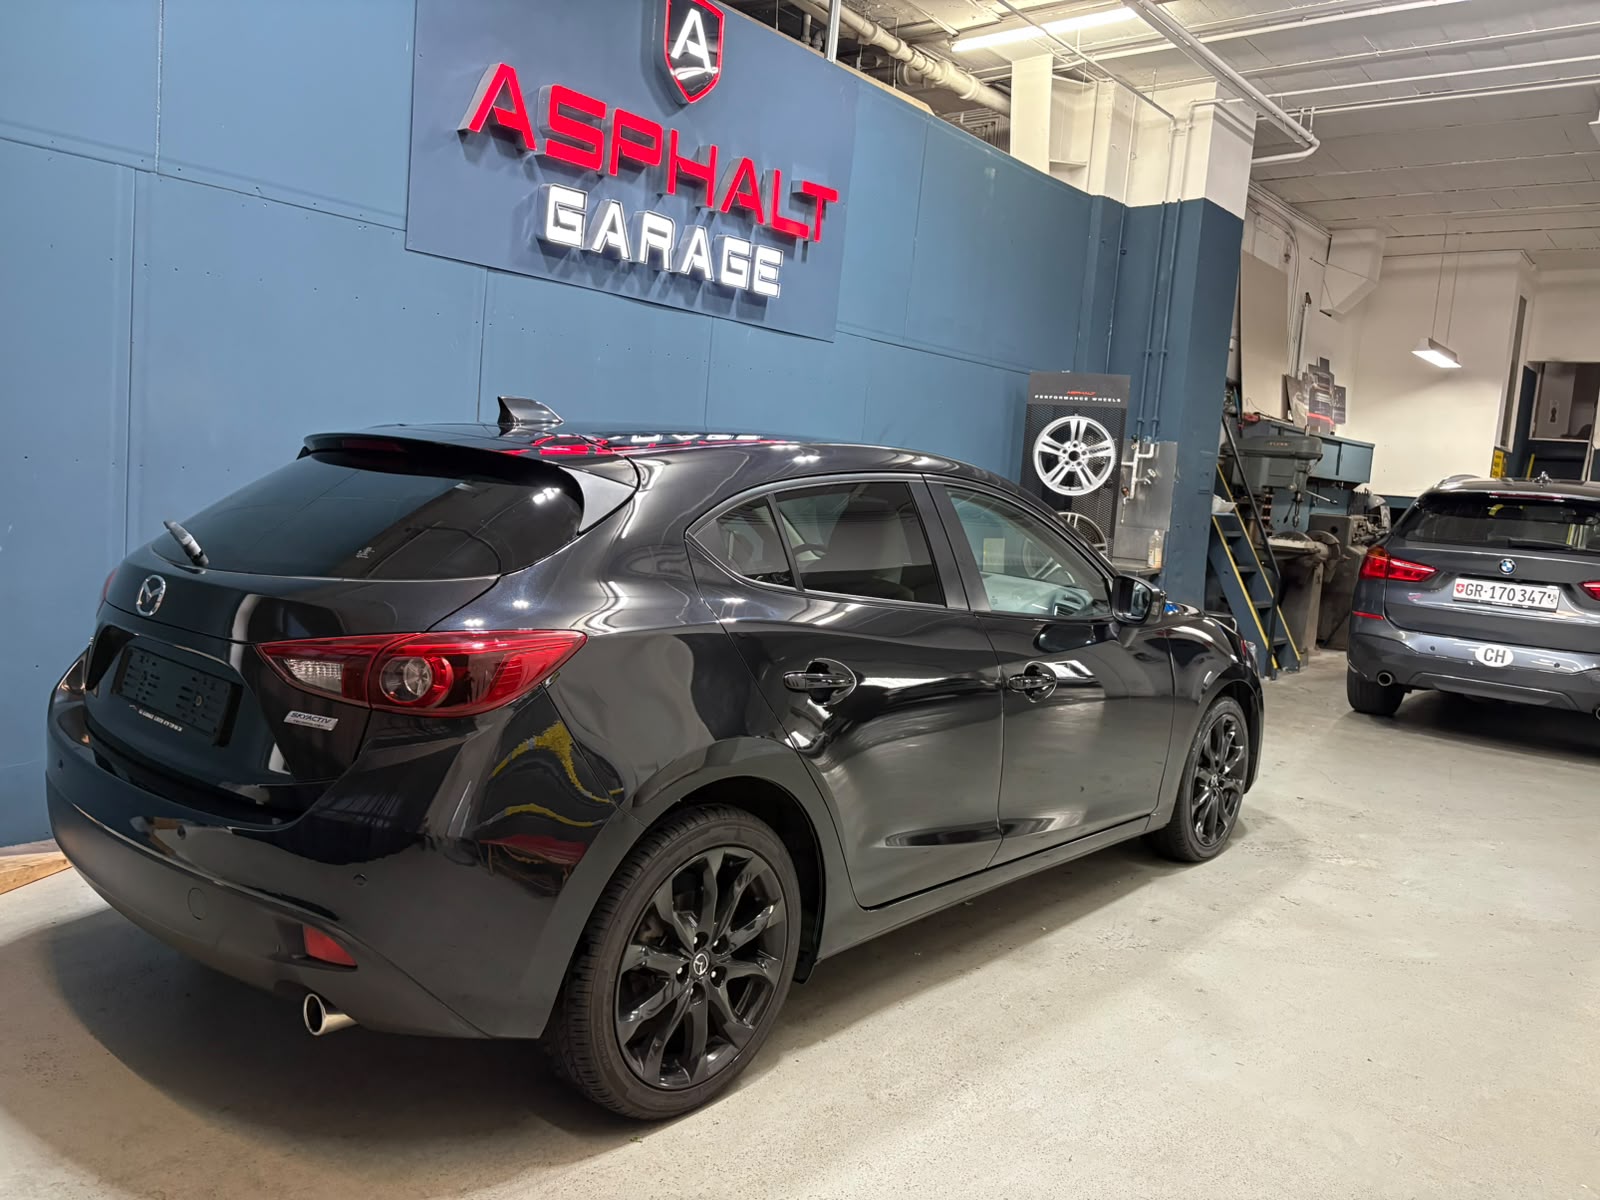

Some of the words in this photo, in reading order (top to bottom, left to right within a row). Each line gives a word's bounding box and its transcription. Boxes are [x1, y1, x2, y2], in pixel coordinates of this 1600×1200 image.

[460, 62, 838, 243] ASPHALT
[540, 183, 784, 299] GARAGE
[1484, 647, 1506, 664] CH
[291, 712, 332, 724] SKYACTIV
